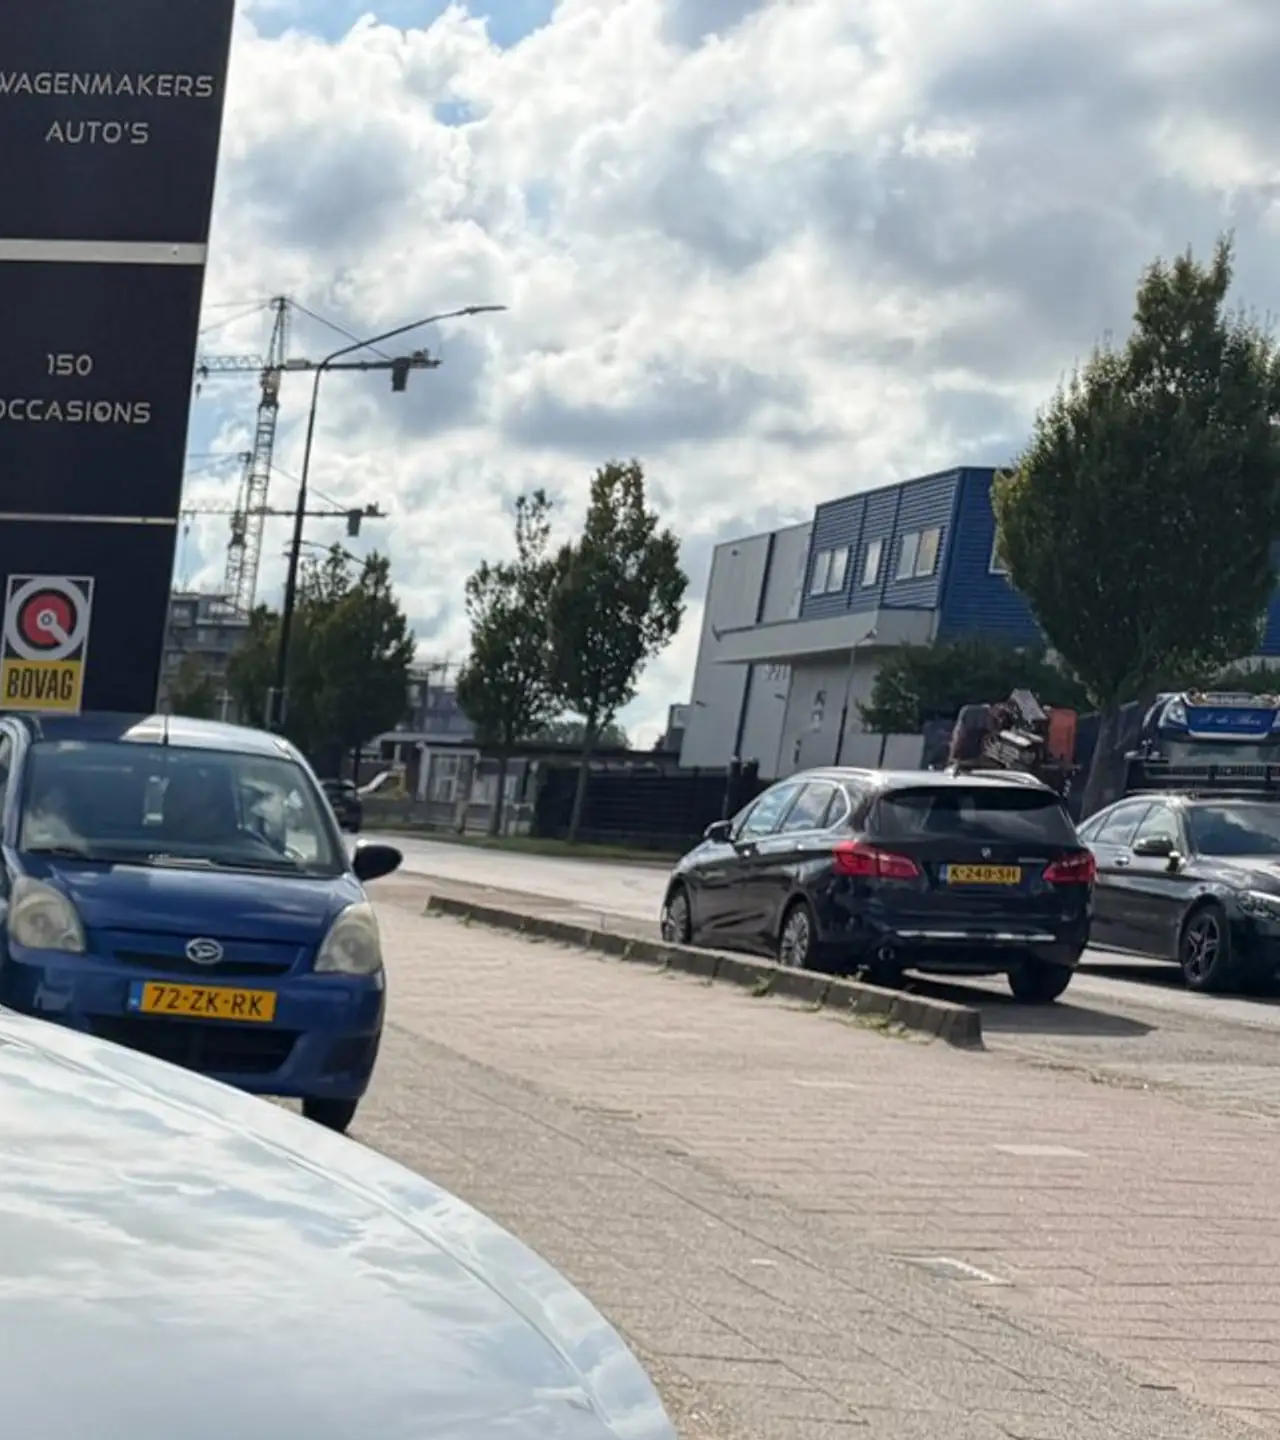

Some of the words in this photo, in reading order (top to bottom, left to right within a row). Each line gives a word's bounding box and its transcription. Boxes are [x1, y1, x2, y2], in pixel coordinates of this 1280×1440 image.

[44, 120, 149, 144] AUTO'S
[47, 353, 93, 376] 150
[6, 667, 74, 700] BOVAG
[151, 986, 264, 1016] 72-ZK-RK
